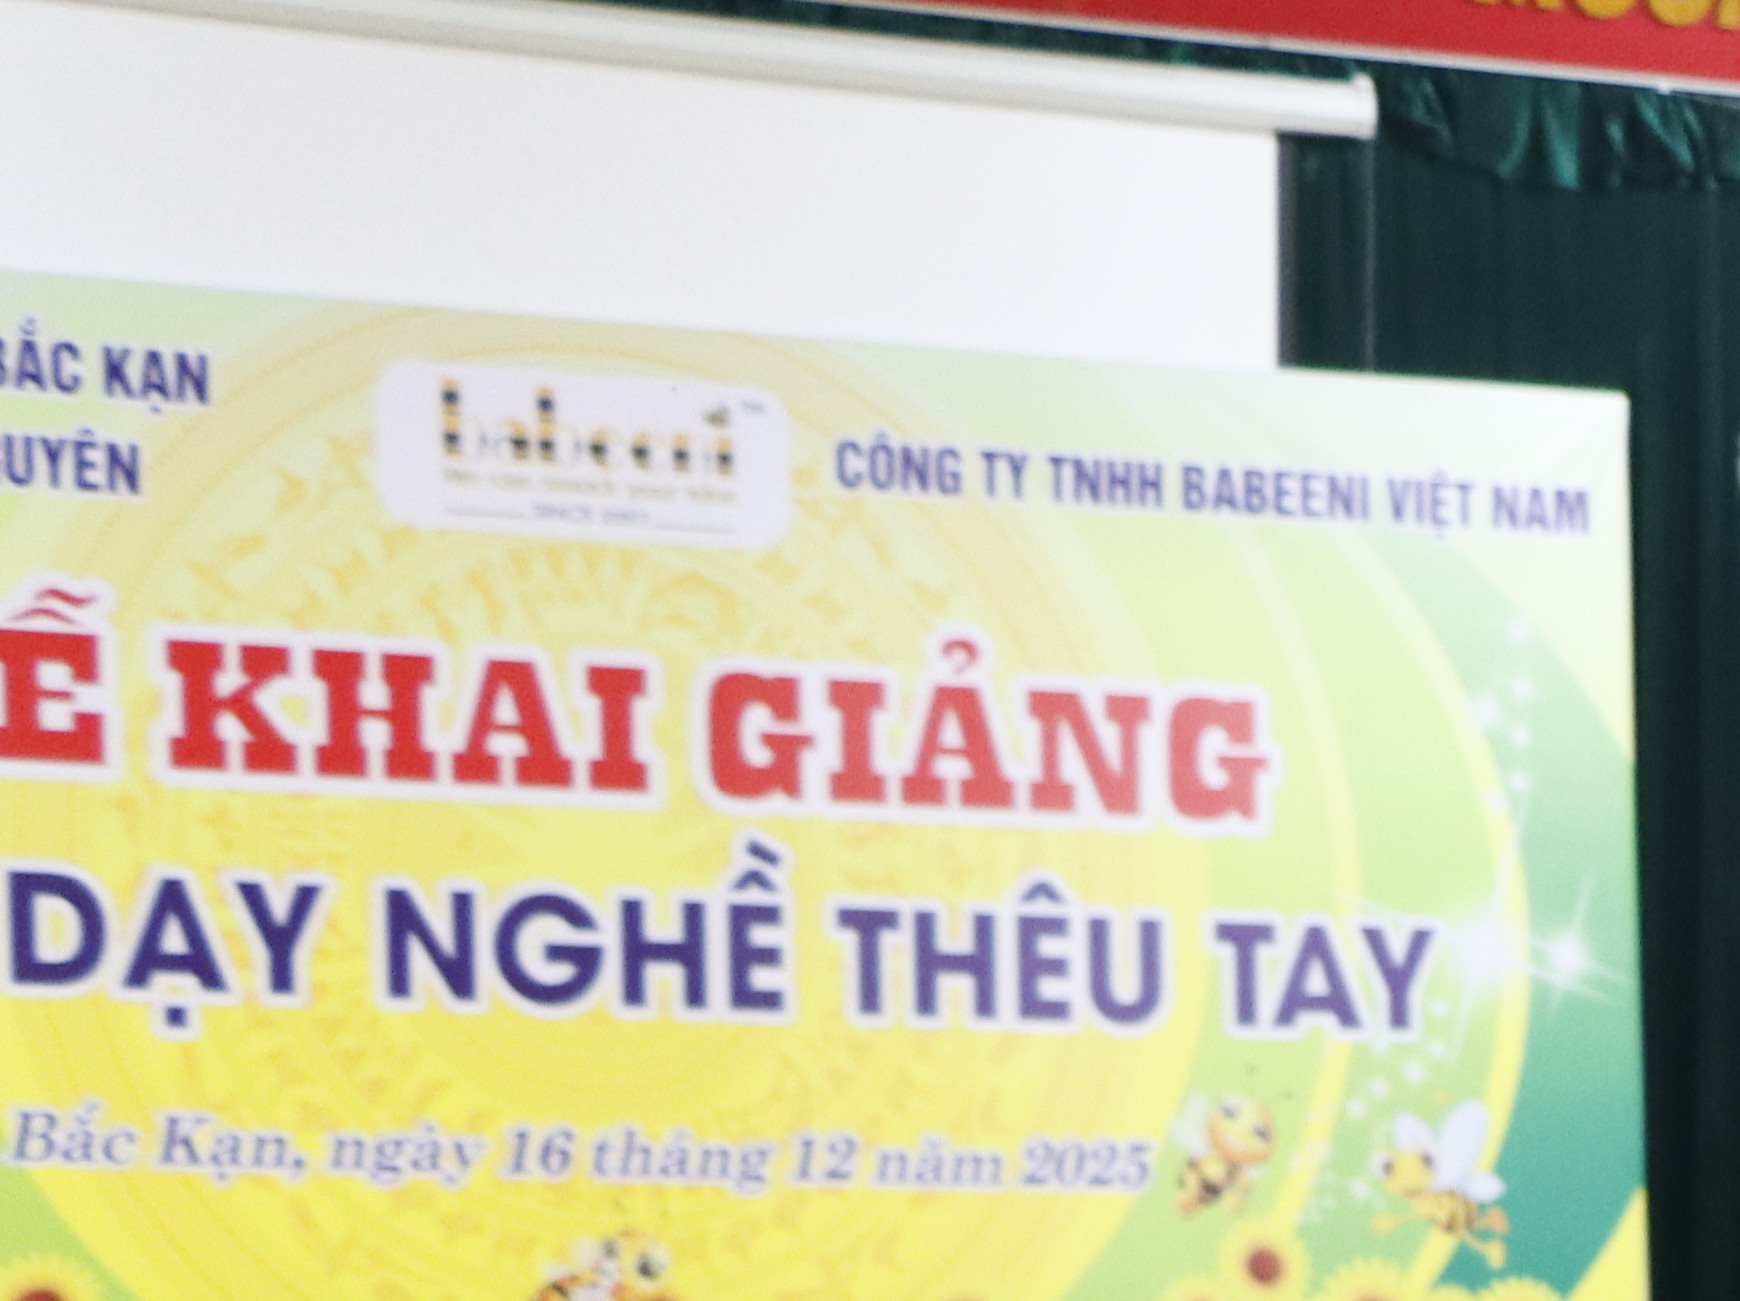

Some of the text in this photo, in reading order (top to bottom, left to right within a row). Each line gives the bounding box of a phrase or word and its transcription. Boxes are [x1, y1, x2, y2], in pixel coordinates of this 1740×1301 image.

[0, 317, 209, 413] ẮC KẠN
[0, 427, 140, 495] UYÊN
[834, 429, 1590, 539] CÔNG TY TNHH BABEENI VIỆT NAM
[165, 638, 650, 794] KHAI
[708, 637, 1271, 824] GIẢNG
[8, 839, 1437, 1032] DẠY NGHỀ THÊU TAY
[13, 1101, 1152, 1192] Bắc Kạn, ngày 16 tháng 12 năm 2025
